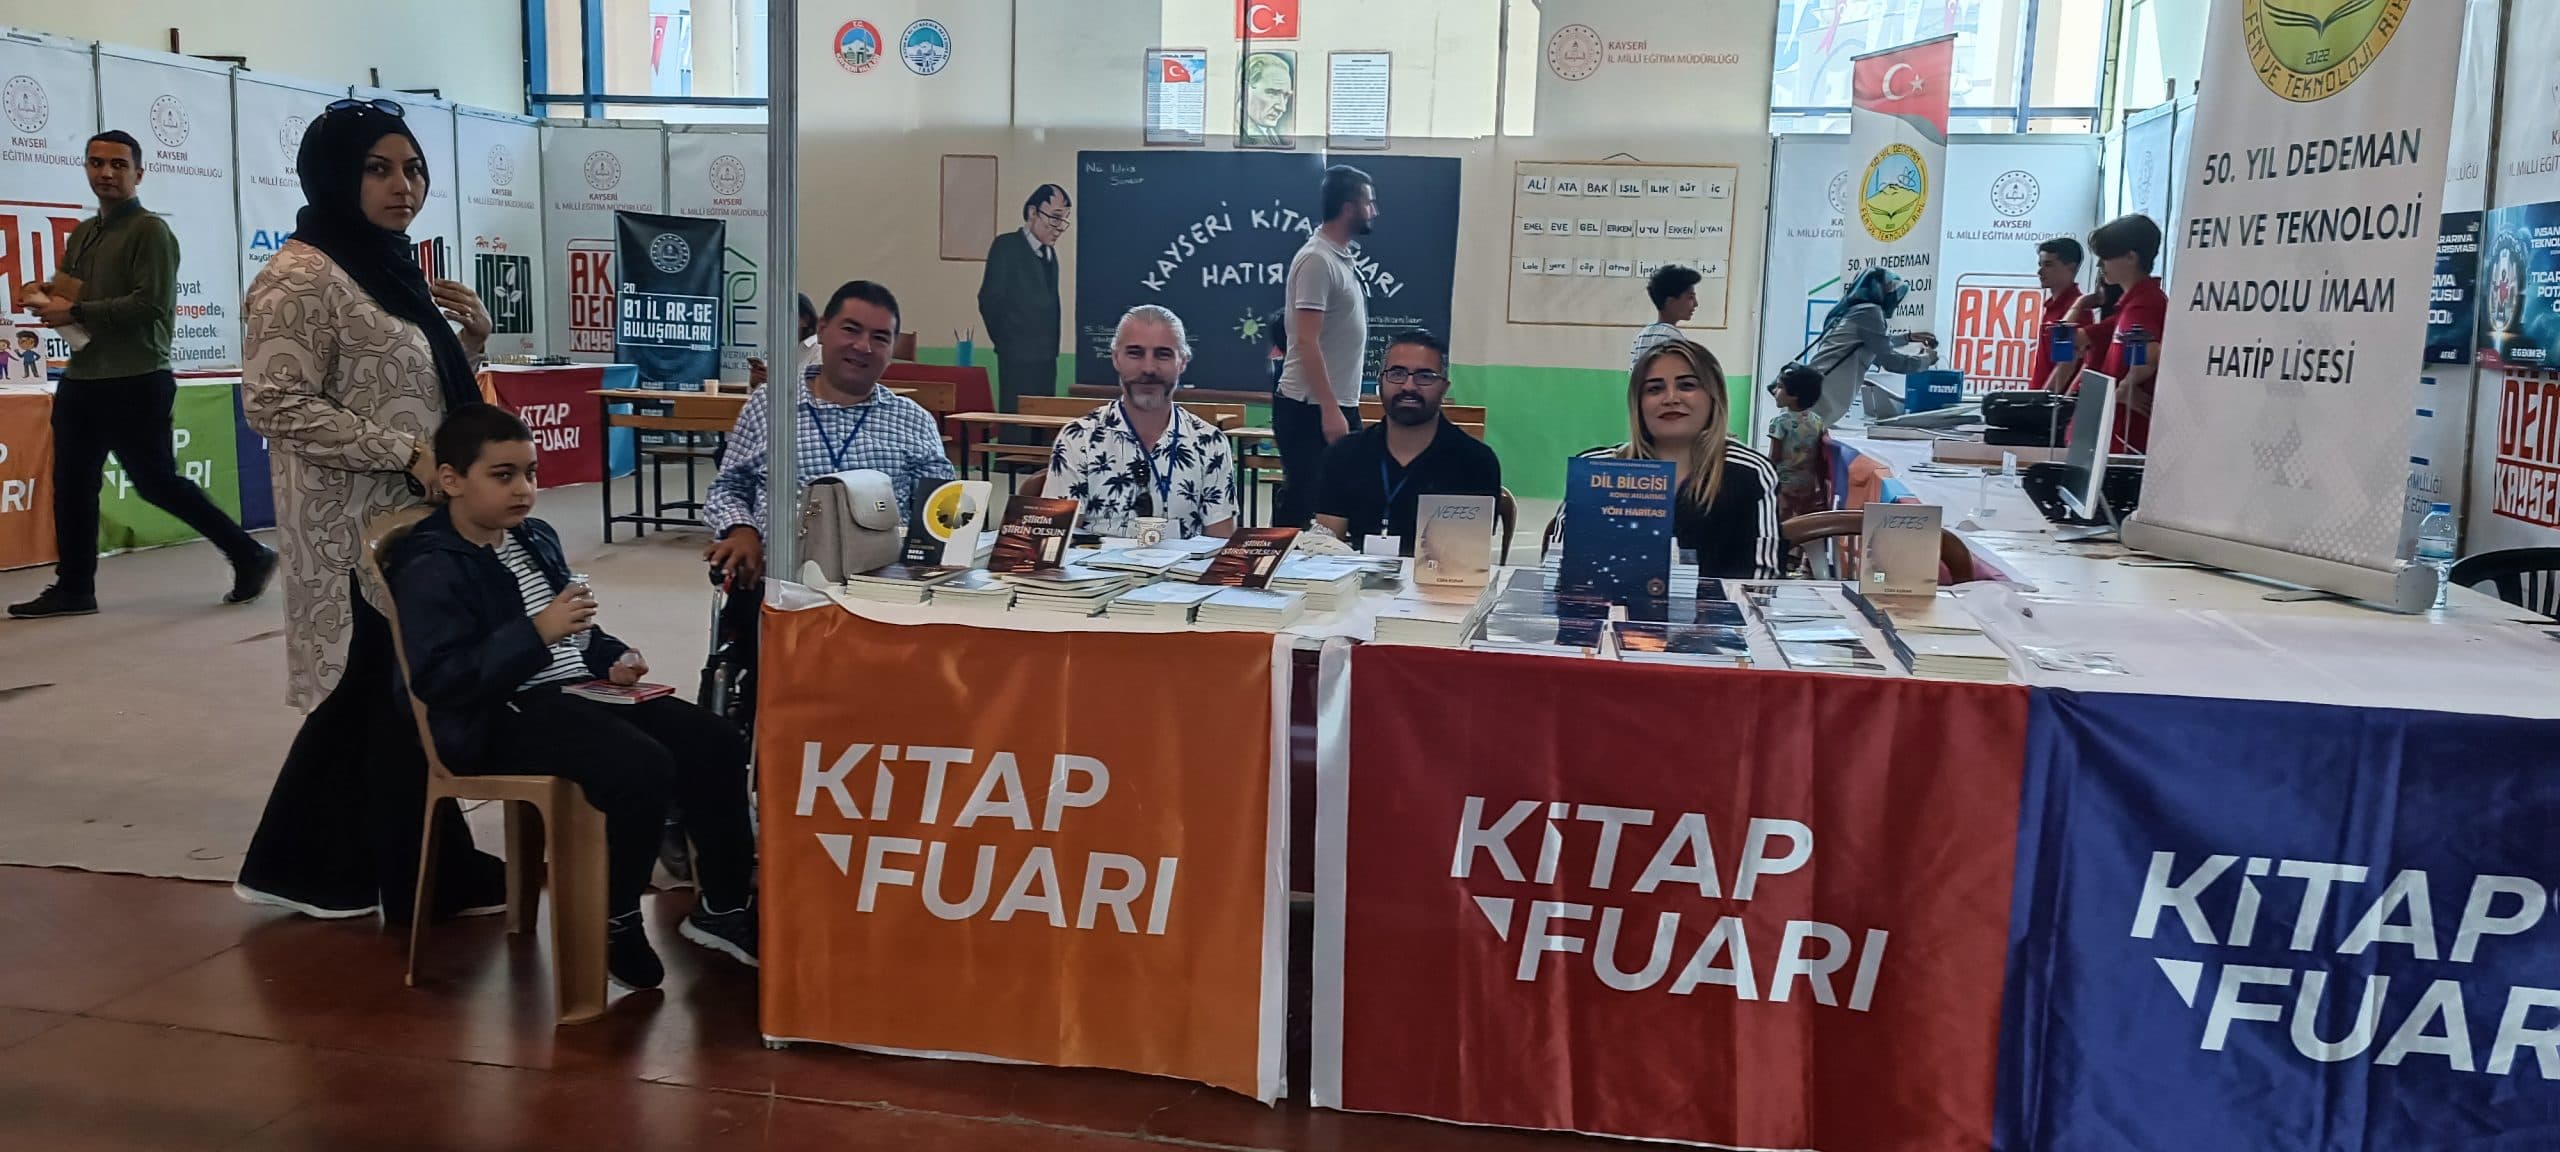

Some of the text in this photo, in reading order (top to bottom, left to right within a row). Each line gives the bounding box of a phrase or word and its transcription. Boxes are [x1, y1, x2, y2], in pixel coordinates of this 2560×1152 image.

[1608, 40, 1647, 50] KAYSERİ
[1618, 54, 1642, 64] MİLLİ
[1644, 53, 1676, 64] EĞİTİM
[1677, 53, 1739, 65] MÜDÜRLÜĞÜ
[11, 136, 47, 149] KAYSERİ
[157, 150, 188, 162] KAYSERİ
[2202, 152, 2236, 186] 50.
[2246, 147, 2278, 180] YIL
[2286, 128, 2421, 177] DEDEMAN
[2540, 154, 2560, 172] EĞİT
[1527, 178, 1548, 191] ALİ
[1558, 183, 1578, 192] ATA
[1587, 183, 1609, 193] BAK
[589, 193, 618, 201] KAYSERİ
[713, 197, 742, 206] KAYSERİ
[1551, 222, 1569, 231] EVE
[1579, 222, 1599, 232] GEL
[1700, 225, 1724, 234] UYAN
[1992, 219, 2032, 229] KAYSERİ
[2187, 192, 2423, 248] FEN VE TEKNOLOJİ
[1956, 231, 1980, 240] MİLLİ
[1982, 231, 2013, 241] EĞİTİM
[1141, 199, 1404, 299] KAYSERİ KİTA UARI
[1848, 258, 1862, 272] 50.
[1881, 253, 1930, 268] DEDEMAN
[571, 252, 614, 294] AK
[1202, 262, 1285, 288] HATIR
[176, 280, 201, 297] ayat
[2188, 270, 2395, 312] ANADOLU İMAM
[176, 301, 225, 319] engede,
[646, 296, 660, 320] İL
[666, 302, 712, 323] AR-GE
[1956, 289, 2042, 339] AKA
[173, 324, 217, 338] elecek
[571, 330, 612, 351] KAYS
[623, 321, 711, 343] BULUŞMALARI
[2206, 337, 2356, 384] HATİP LİSESİ
[1928, 383, 1958, 395] mavi
[1591, 472, 1667, 491] DİL BİLGİSİ
[1434, 505, 1480, 520] NEFES
[1032, 527, 1066, 537] OLSUN
[795, 742, 1110, 832] KİTAP
[1450, 796, 1814, 900] KİTAP
[856, 836, 1179, 935] FUARI
[2130, 851, 2547, 963] KİTAP
[1516, 900, 1889, 1012] FUARI
